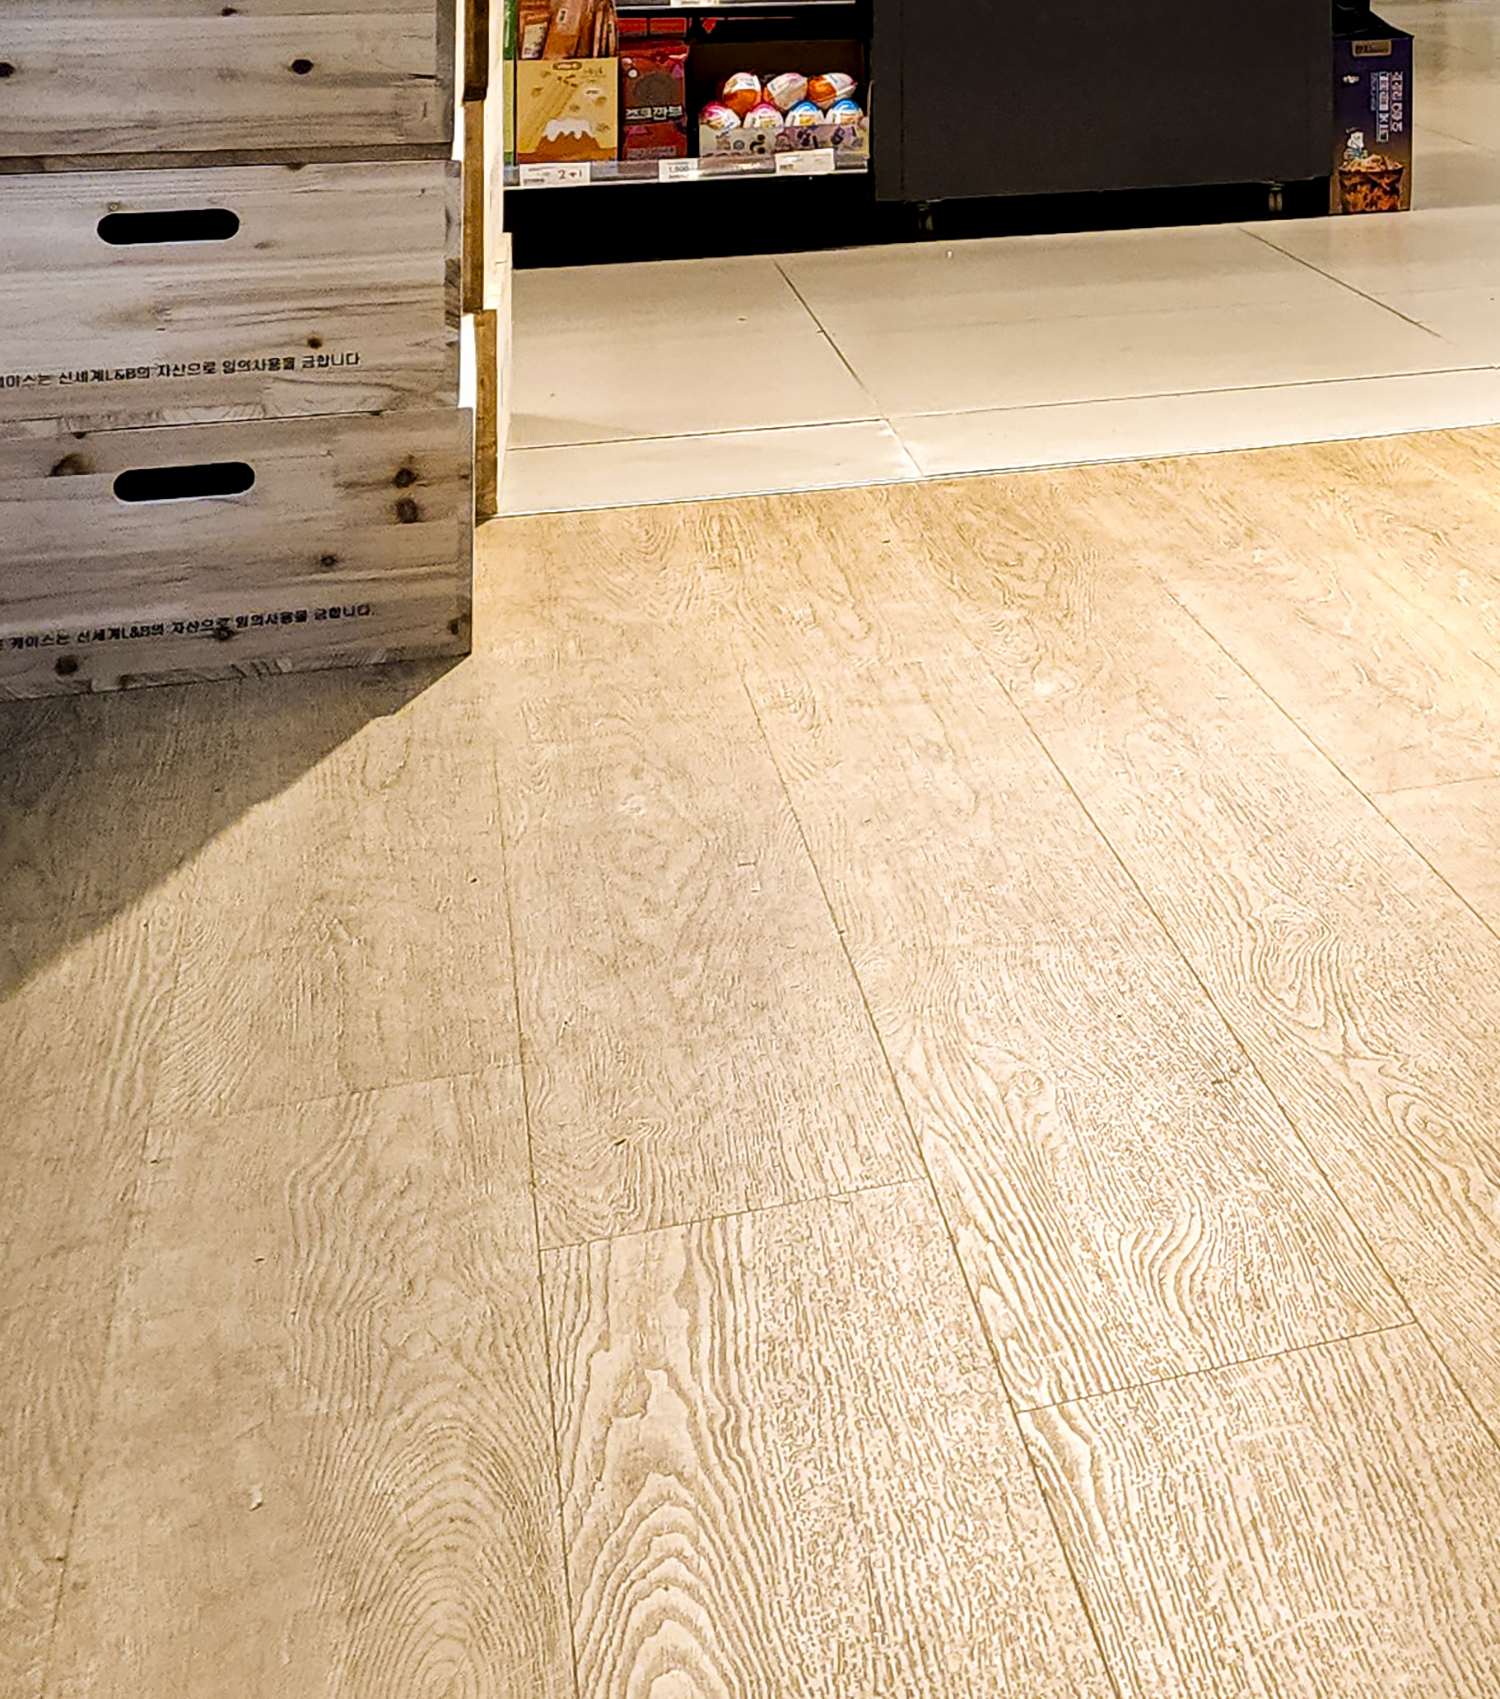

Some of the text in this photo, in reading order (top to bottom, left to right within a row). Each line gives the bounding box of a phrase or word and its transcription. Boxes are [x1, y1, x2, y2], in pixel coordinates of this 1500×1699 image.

[59, 366, 151, 385] 신세계L&B의
[158, 362, 217, 378] 자산으로
[223, 357, 296, 374] 임의사용을
[302, 352, 360, 369] 금합니다
[8, 633, 70, 649] 케이스는
[77, 623, 164, 643] 신세계L&B의
[172, 617, 229, 634] 자산으로
[236, 610, 307, 628] 임의사용을
